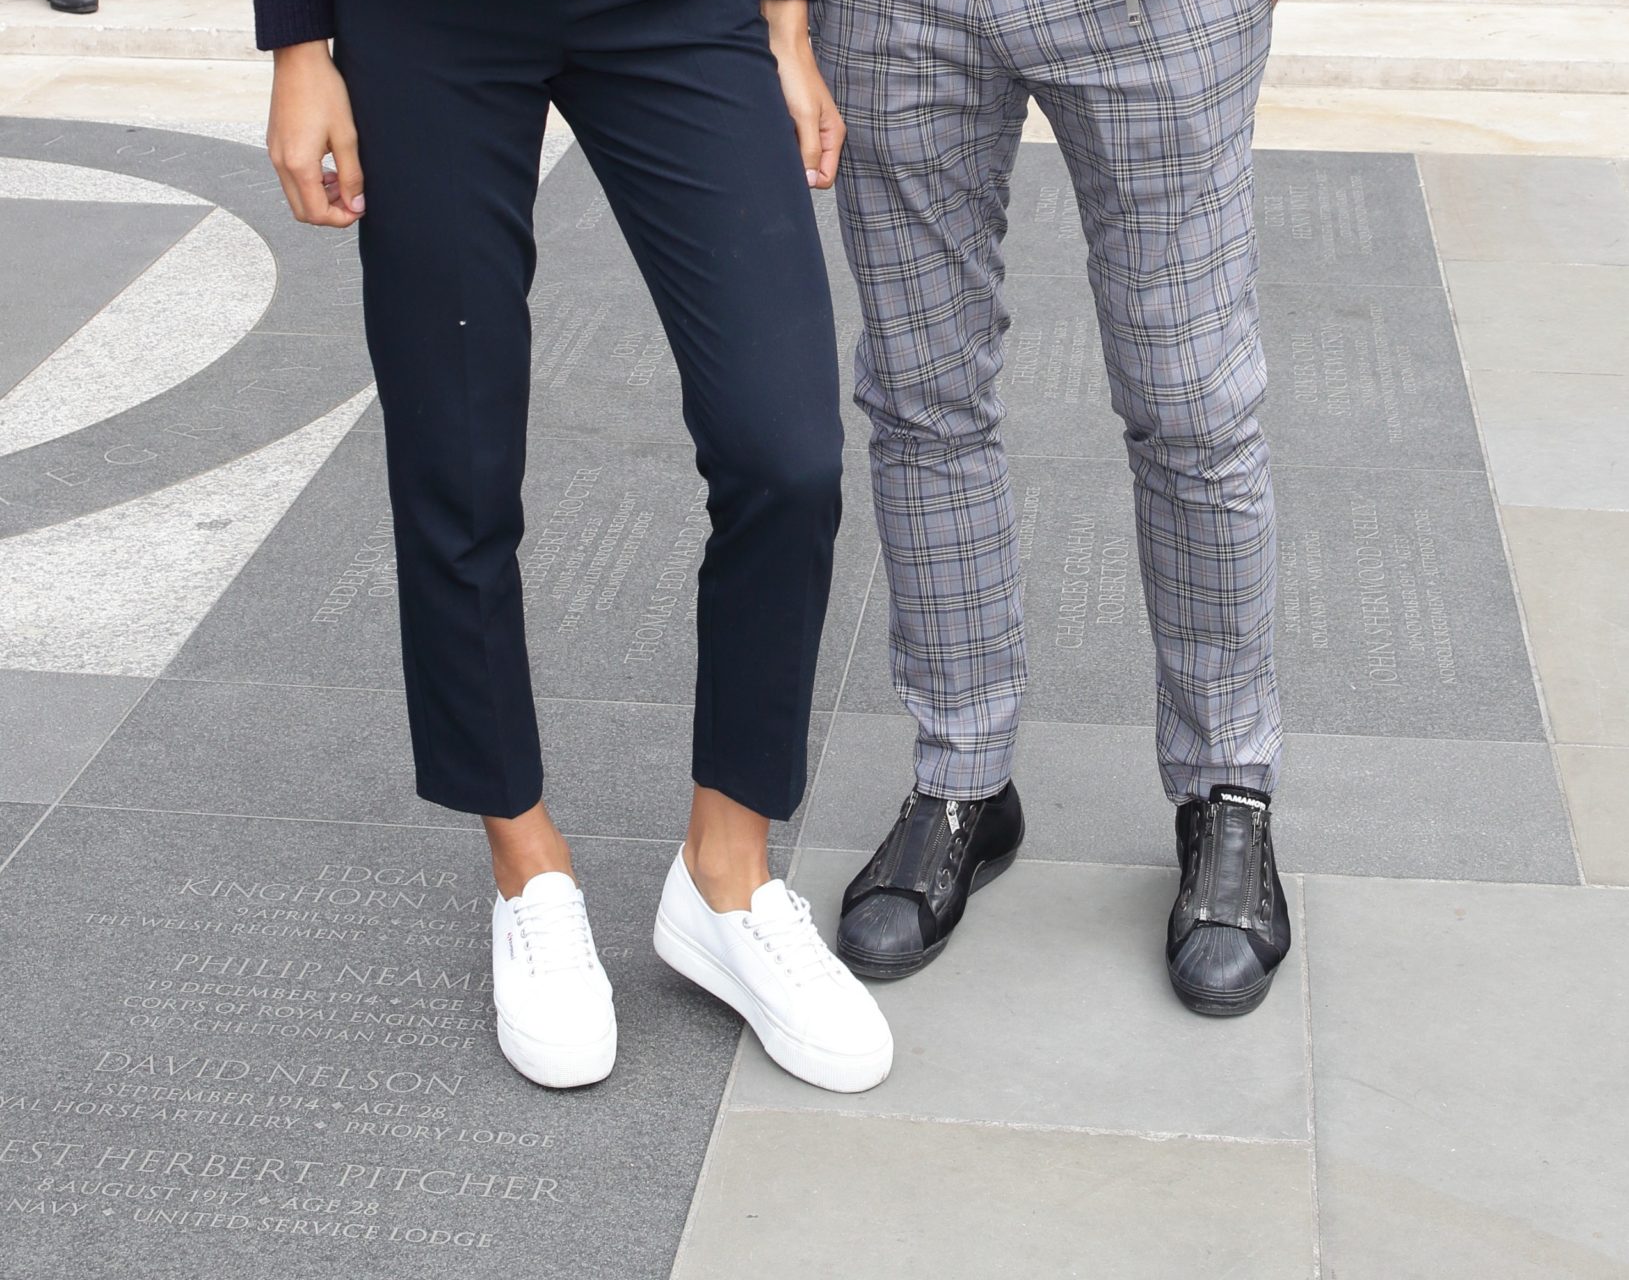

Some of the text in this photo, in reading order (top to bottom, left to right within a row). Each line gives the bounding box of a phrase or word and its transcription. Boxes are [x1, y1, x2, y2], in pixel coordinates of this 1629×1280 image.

[311, 542, 390, 623] FREDERICK
[623, 596, 678, 664] THOMAS
[656, 527, 705, 590] EDWARD
[1055, 513, 1095, 649] CHARLES GRAHAM
[1096, 535, 1129, 624] ROBERTSON
[1365, 641, 1401, 688] JOHN
[179, 878, 426, 910] KINGHORN
[315, 864, 458, 888] EDGAR
[85, 912, 132, 926] THE
[141, 916, 223, 932] WELSH
[230, 922, 366, 941] REGIMENT
[252, 909, 322, 923] APRIL
[410, 918, 467, 932] AGE
[175, 953, 322, 980] PHILIP
[123, 995, 209, 1012] CORPS
[215, 1001, 251, 1016] OF
[257, 1004, 339, 1021] ROYAL
[148, 979, 173, 991] 19
[180, 981, 318, 1002] DECEMBER
[327, 991, 378, 1006] 1914
[408, 997, 464, 1012] AGE
[129, 1014, 186, 1028] OLD
[382, 1031, 476, 1050] LODGE
[96, 1050, 467, 1096] DAVID NELSON
[101, 1082, 255, 1106] SEPTEMBER
[265, 1094, 319, 1111] 1914
[350, 1101, 411, 1119] AGE
[416, 1104, 447, 1120] 28
[51, 1100, 147, 1118] HORSE
[150, 1107, 301, 1129] ARTILLERY
[344, 1120, 452, 1140] PRIORY
[457, 1129, 556, 1149] LODGE
[95, 1146, 324, 1185] HERBERT
[336, 1163, 565, 1204] PITCHER
[37, 1177, 380, 1216] 8 AUGUST 1917 AGE 28
[5, 1198, 494, 1249] NAVY UNITED SERVICE LODGE
